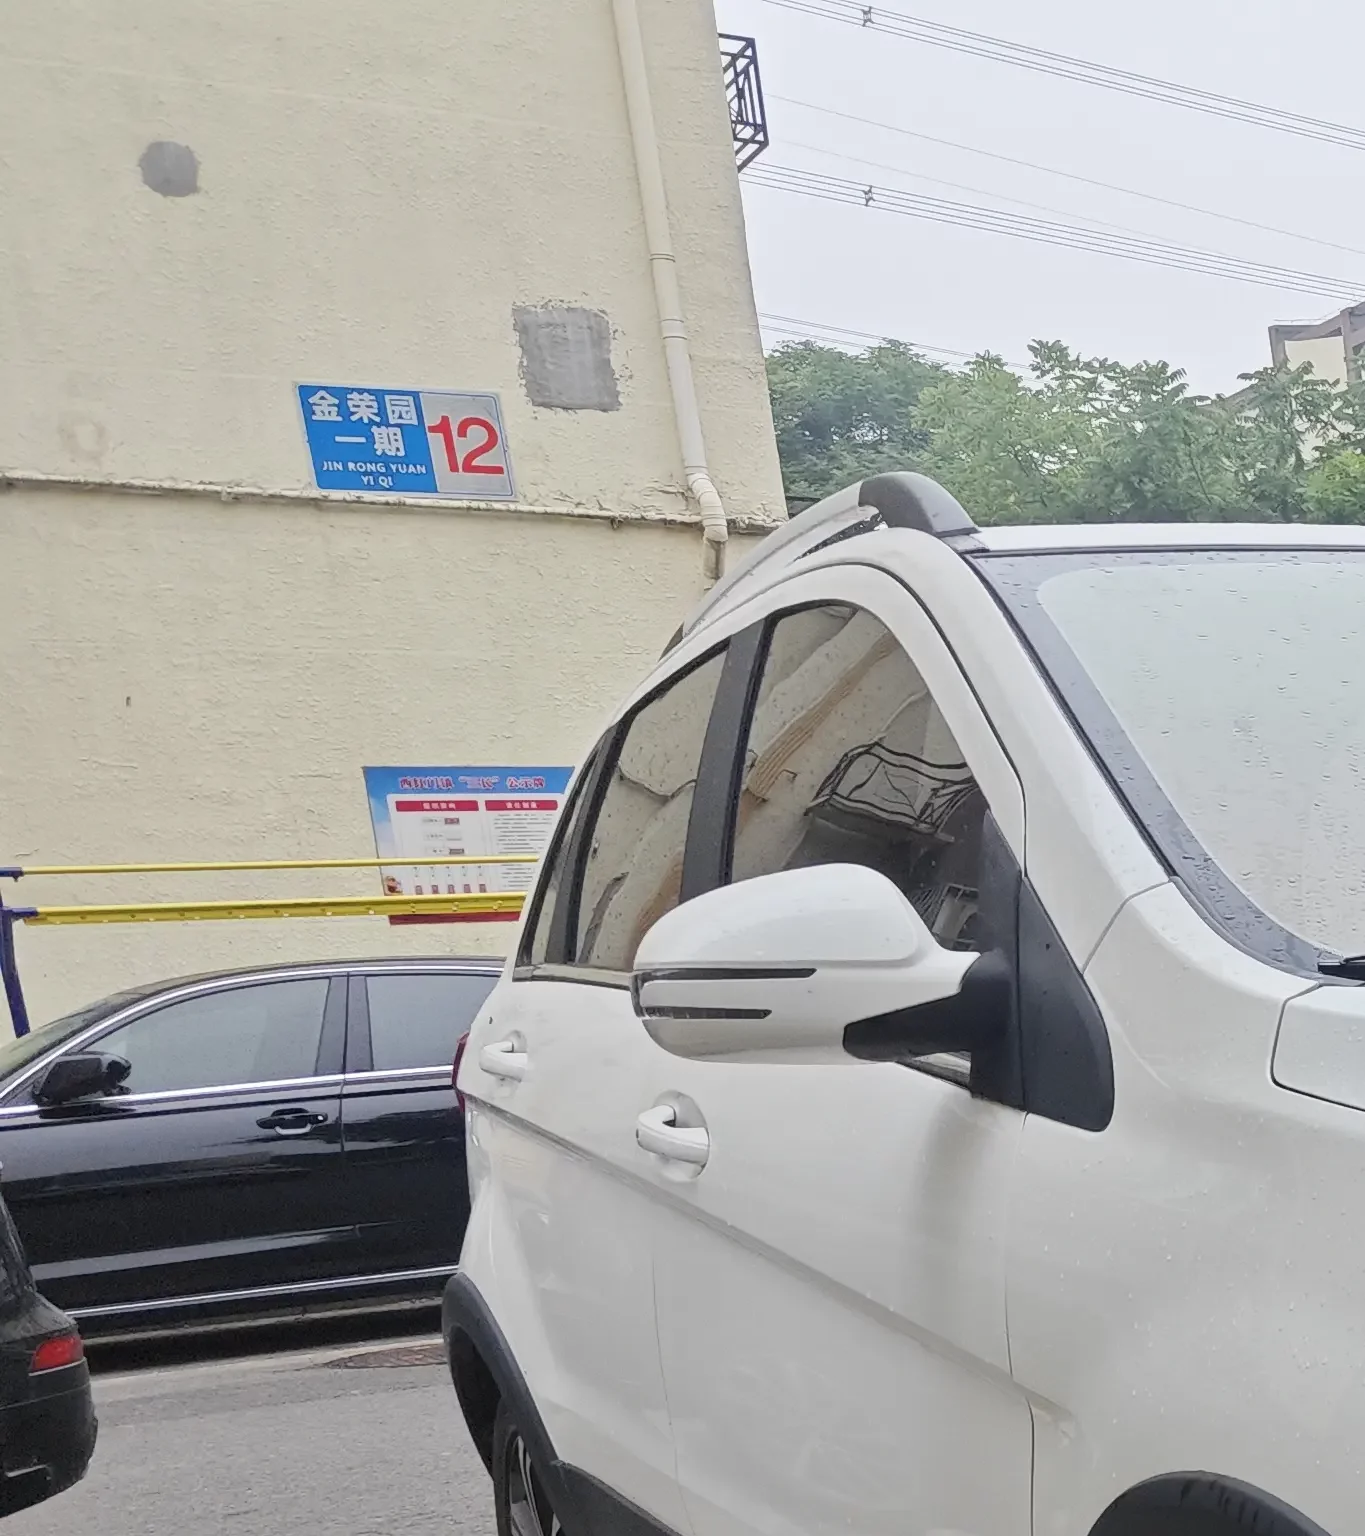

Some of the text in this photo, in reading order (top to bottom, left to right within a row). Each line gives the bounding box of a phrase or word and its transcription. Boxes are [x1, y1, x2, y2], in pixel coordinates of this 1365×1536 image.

[308, 389, 419, 426] 金荣园
[334, 425, 405, 457] 一期
[428, 415, 504, 475] 12
[322, 460, 426, 475] JIN RONG YUAN
[361, 476, 394, 489] YI QI
